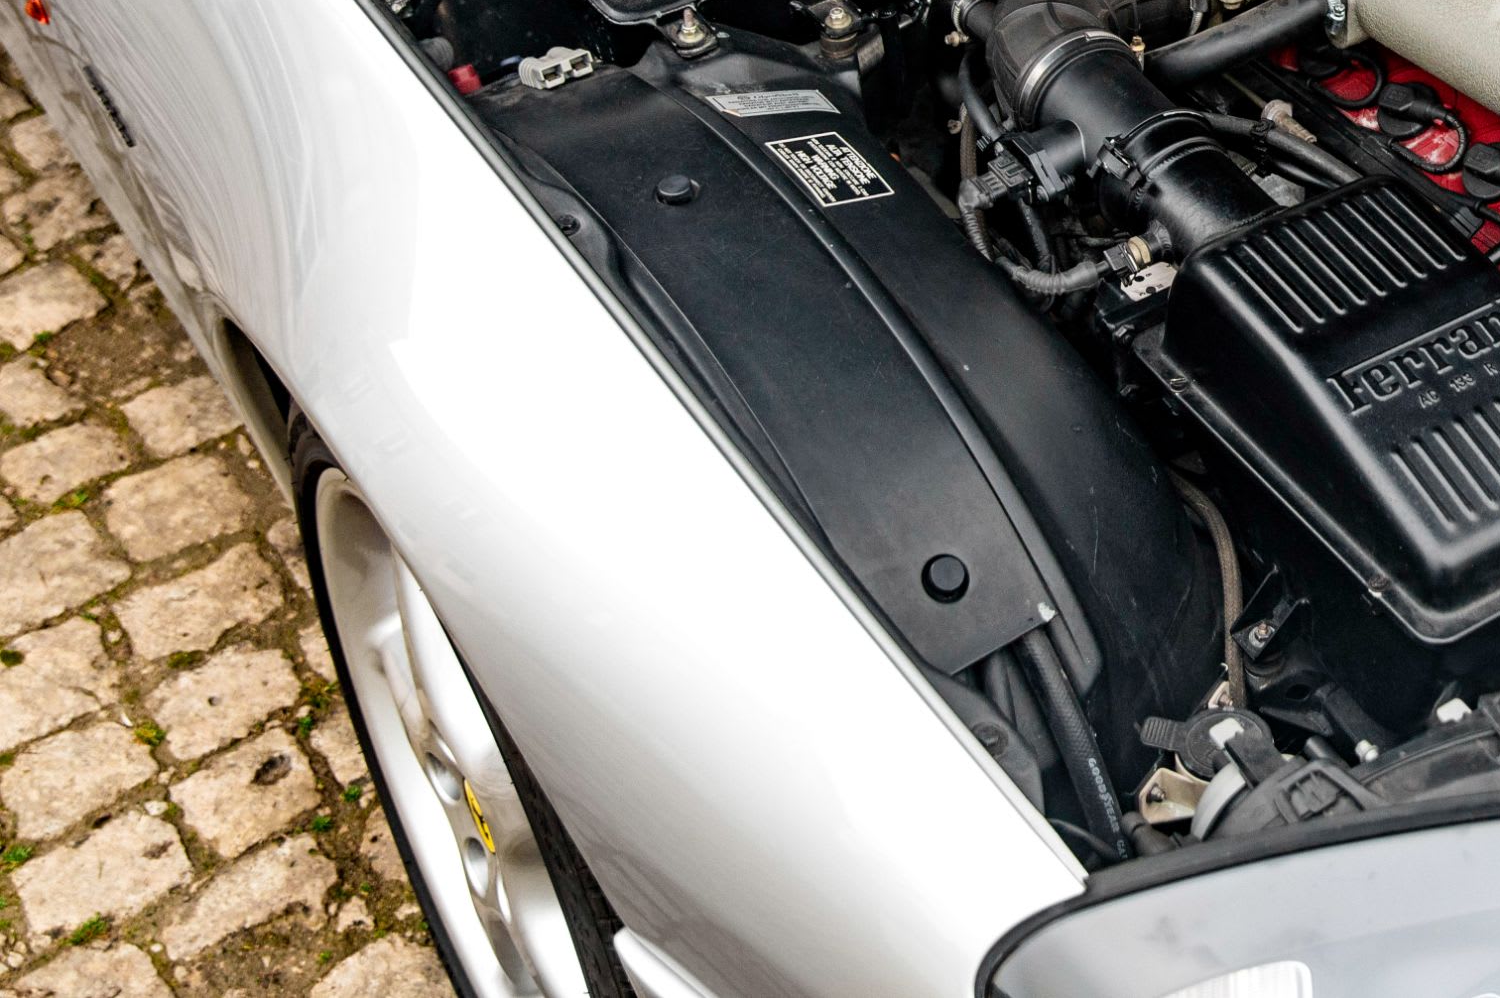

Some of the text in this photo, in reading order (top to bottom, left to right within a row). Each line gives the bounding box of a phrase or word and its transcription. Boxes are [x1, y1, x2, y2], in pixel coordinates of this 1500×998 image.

[810, 164, 838, 190] VOLTAGE
[811, 154, 840, 181] WARNING
[839, 146, 878, 180] ATTENZIONE
[840, 157, 872, 185] TENSIONE
[1088, 757, 1120, 834] GOODYEAR
